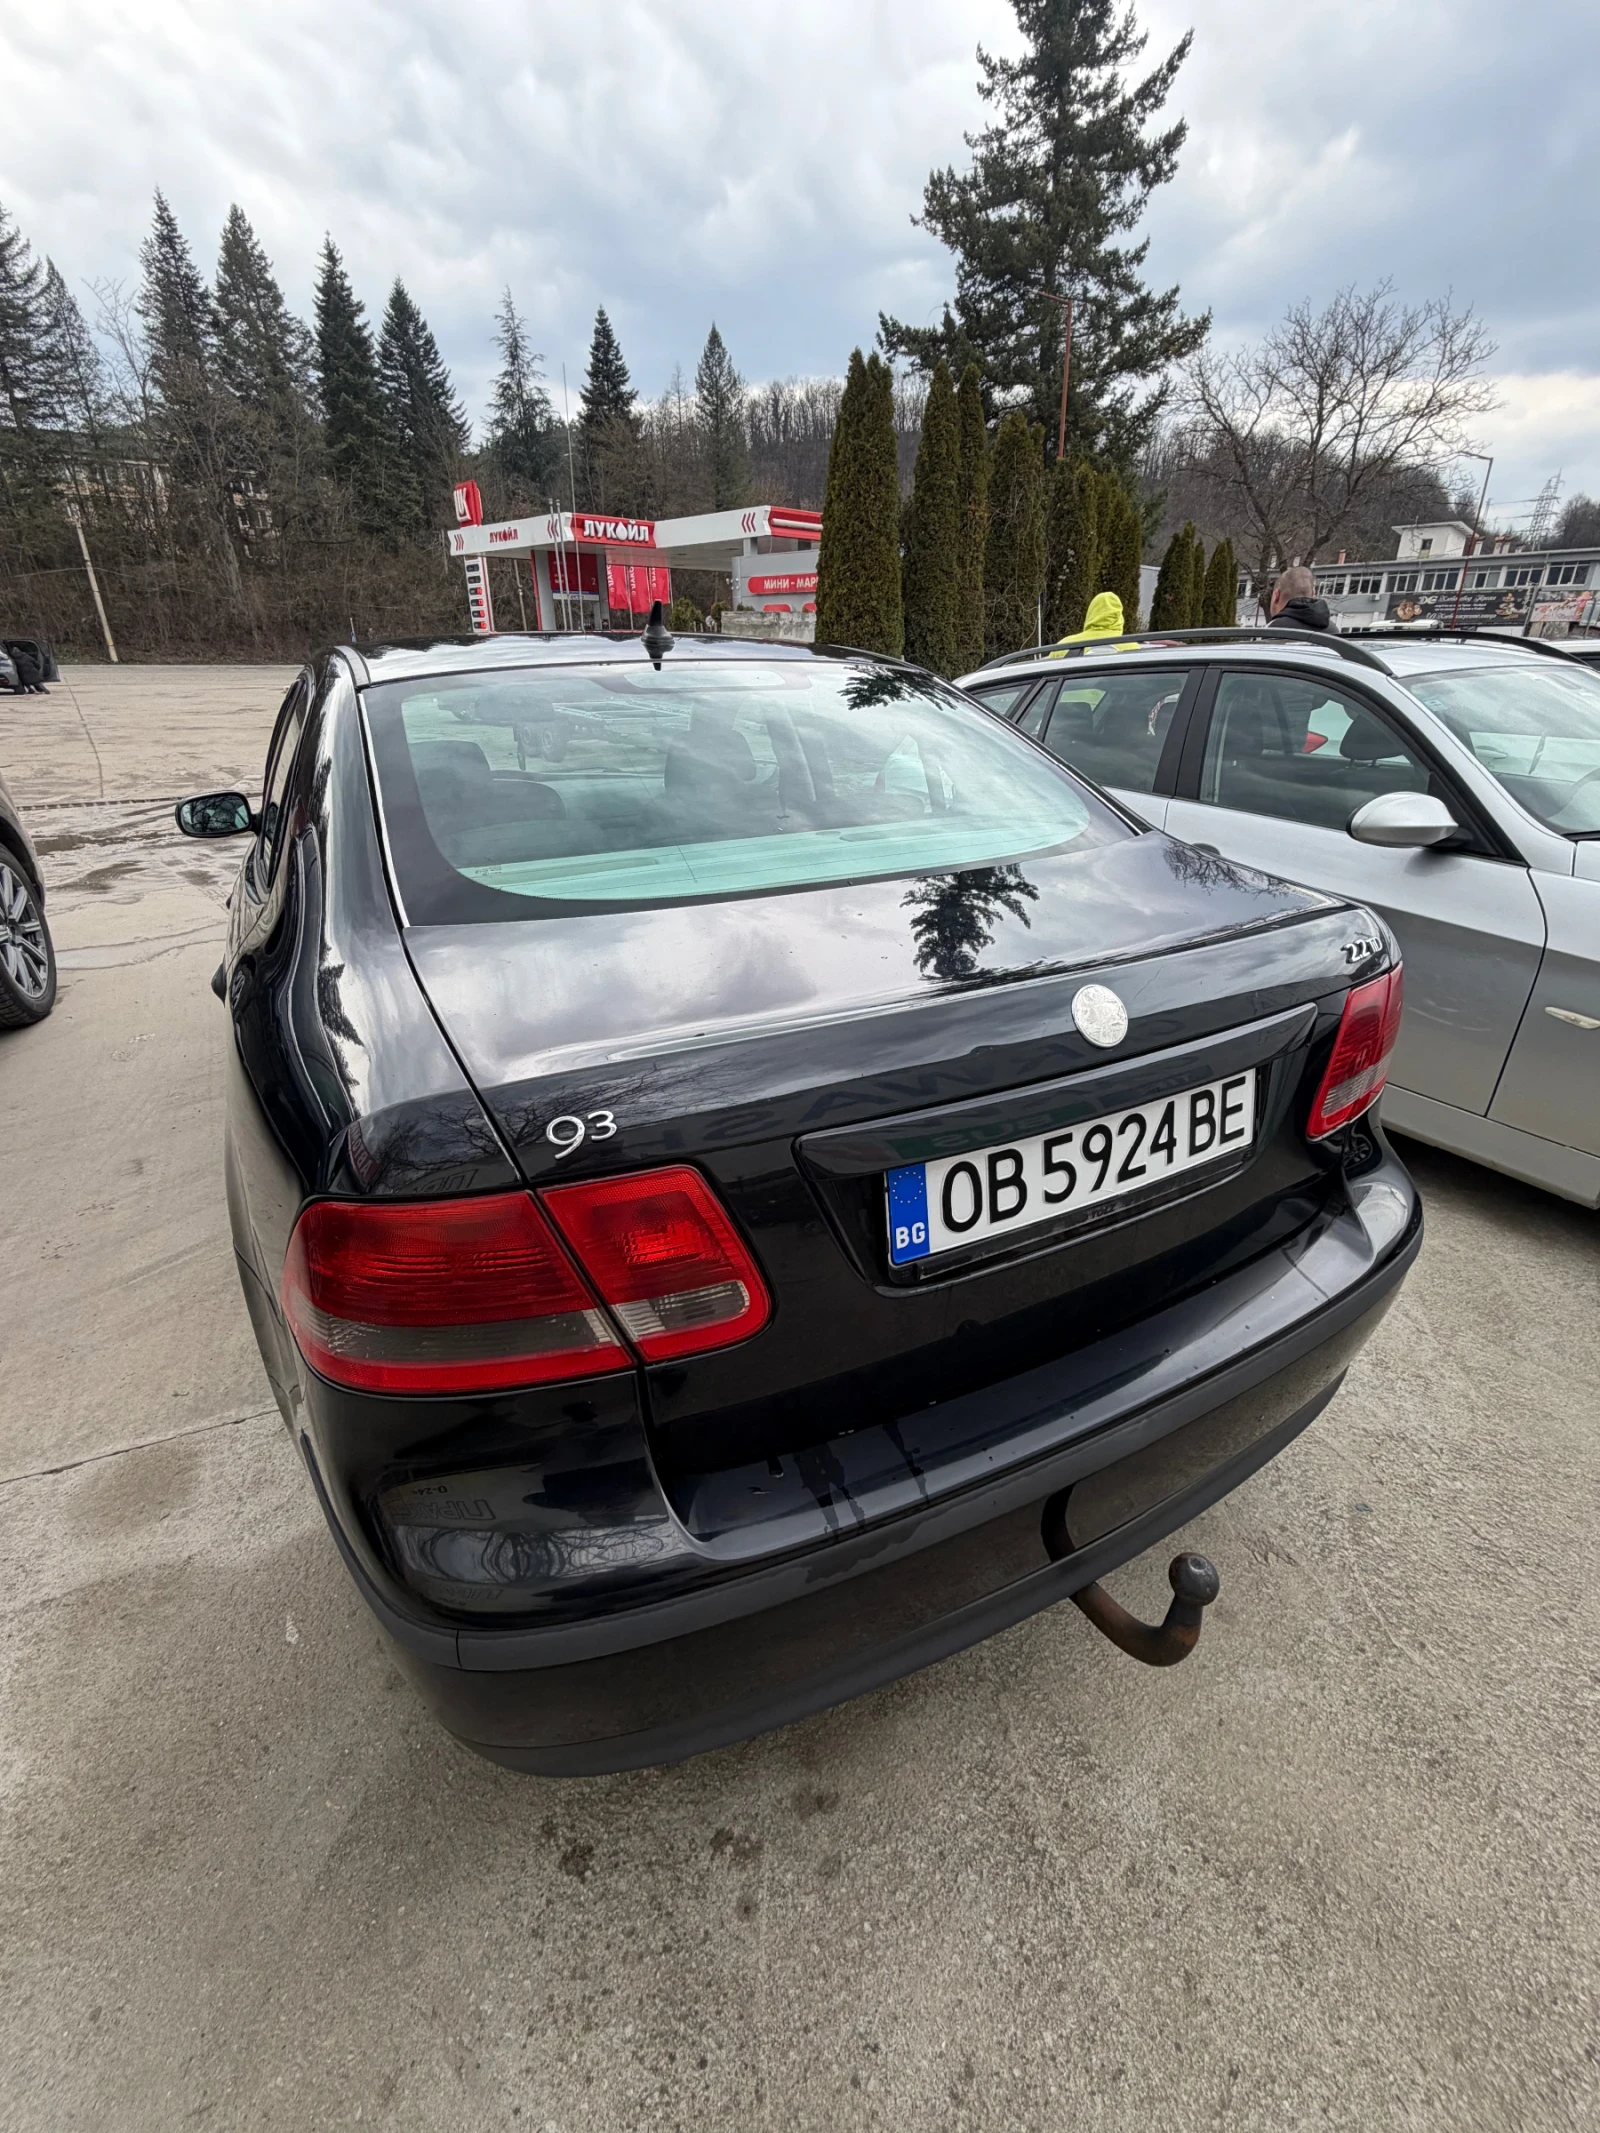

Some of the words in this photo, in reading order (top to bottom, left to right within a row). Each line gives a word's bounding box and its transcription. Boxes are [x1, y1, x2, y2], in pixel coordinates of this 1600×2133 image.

[489, 527, 518, 544] ЛУКОЙЛ
[583, 519, 649, 542] ЛУКОЙЛ
[763, 579, 789, 590] МИНИ
[546, 1110, 618, 1160] 93
[1042, 1101, 1177, 1203] 5924
[894, 1221, 926, 1250] BG
